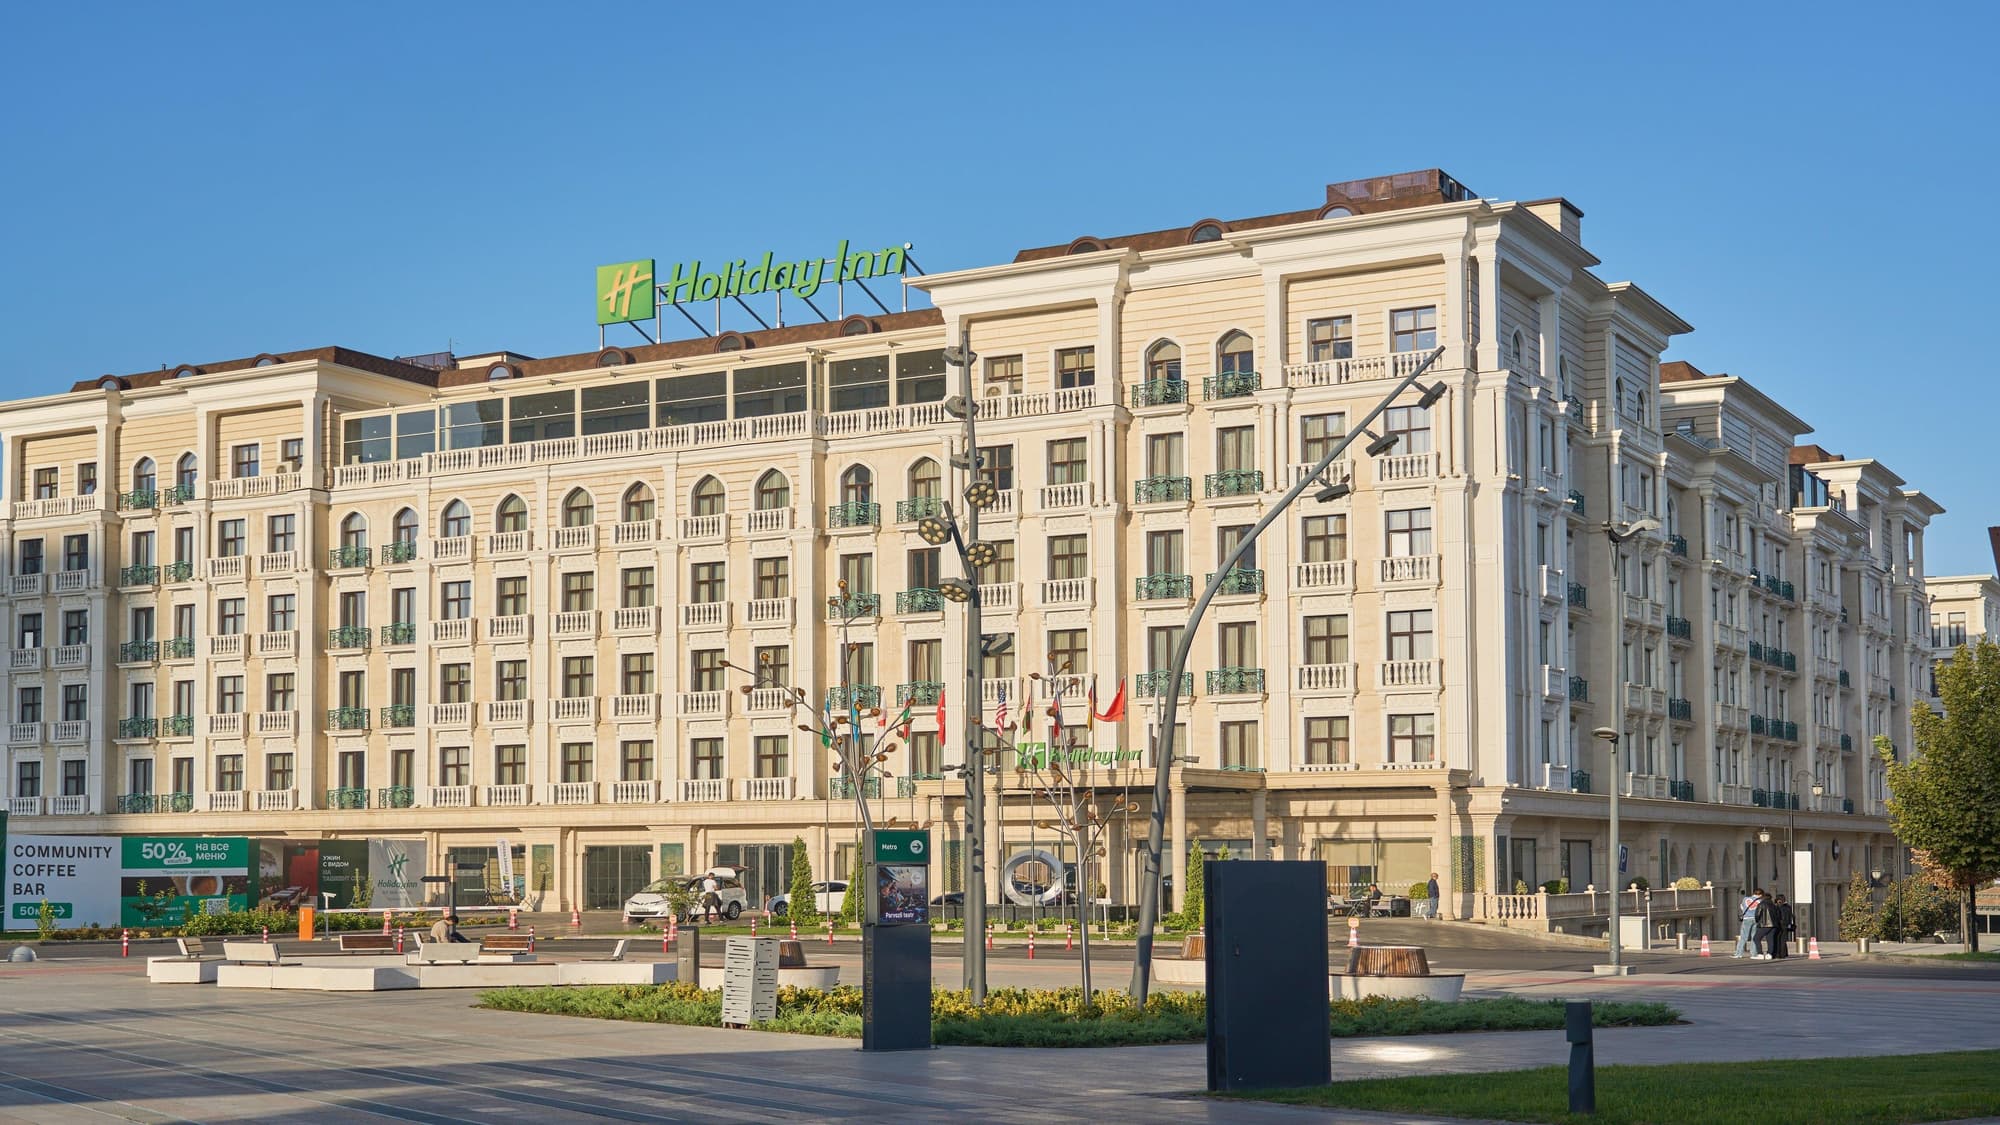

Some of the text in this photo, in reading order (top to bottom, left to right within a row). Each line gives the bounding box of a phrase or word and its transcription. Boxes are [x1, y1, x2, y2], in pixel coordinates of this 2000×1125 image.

[666, 239, 906, 304] Holiday Inn
[1115, 744, 1143, 761] Inn
[13, 845, 112, 859] COMMUNITY
[196, 843, 208, 851] на
[211, 843, 229, 851] все
[196, 852, 227, 860] меню
[13, 864, 76, 877] COFFEE
[13, 883, 46, 896] BAR
